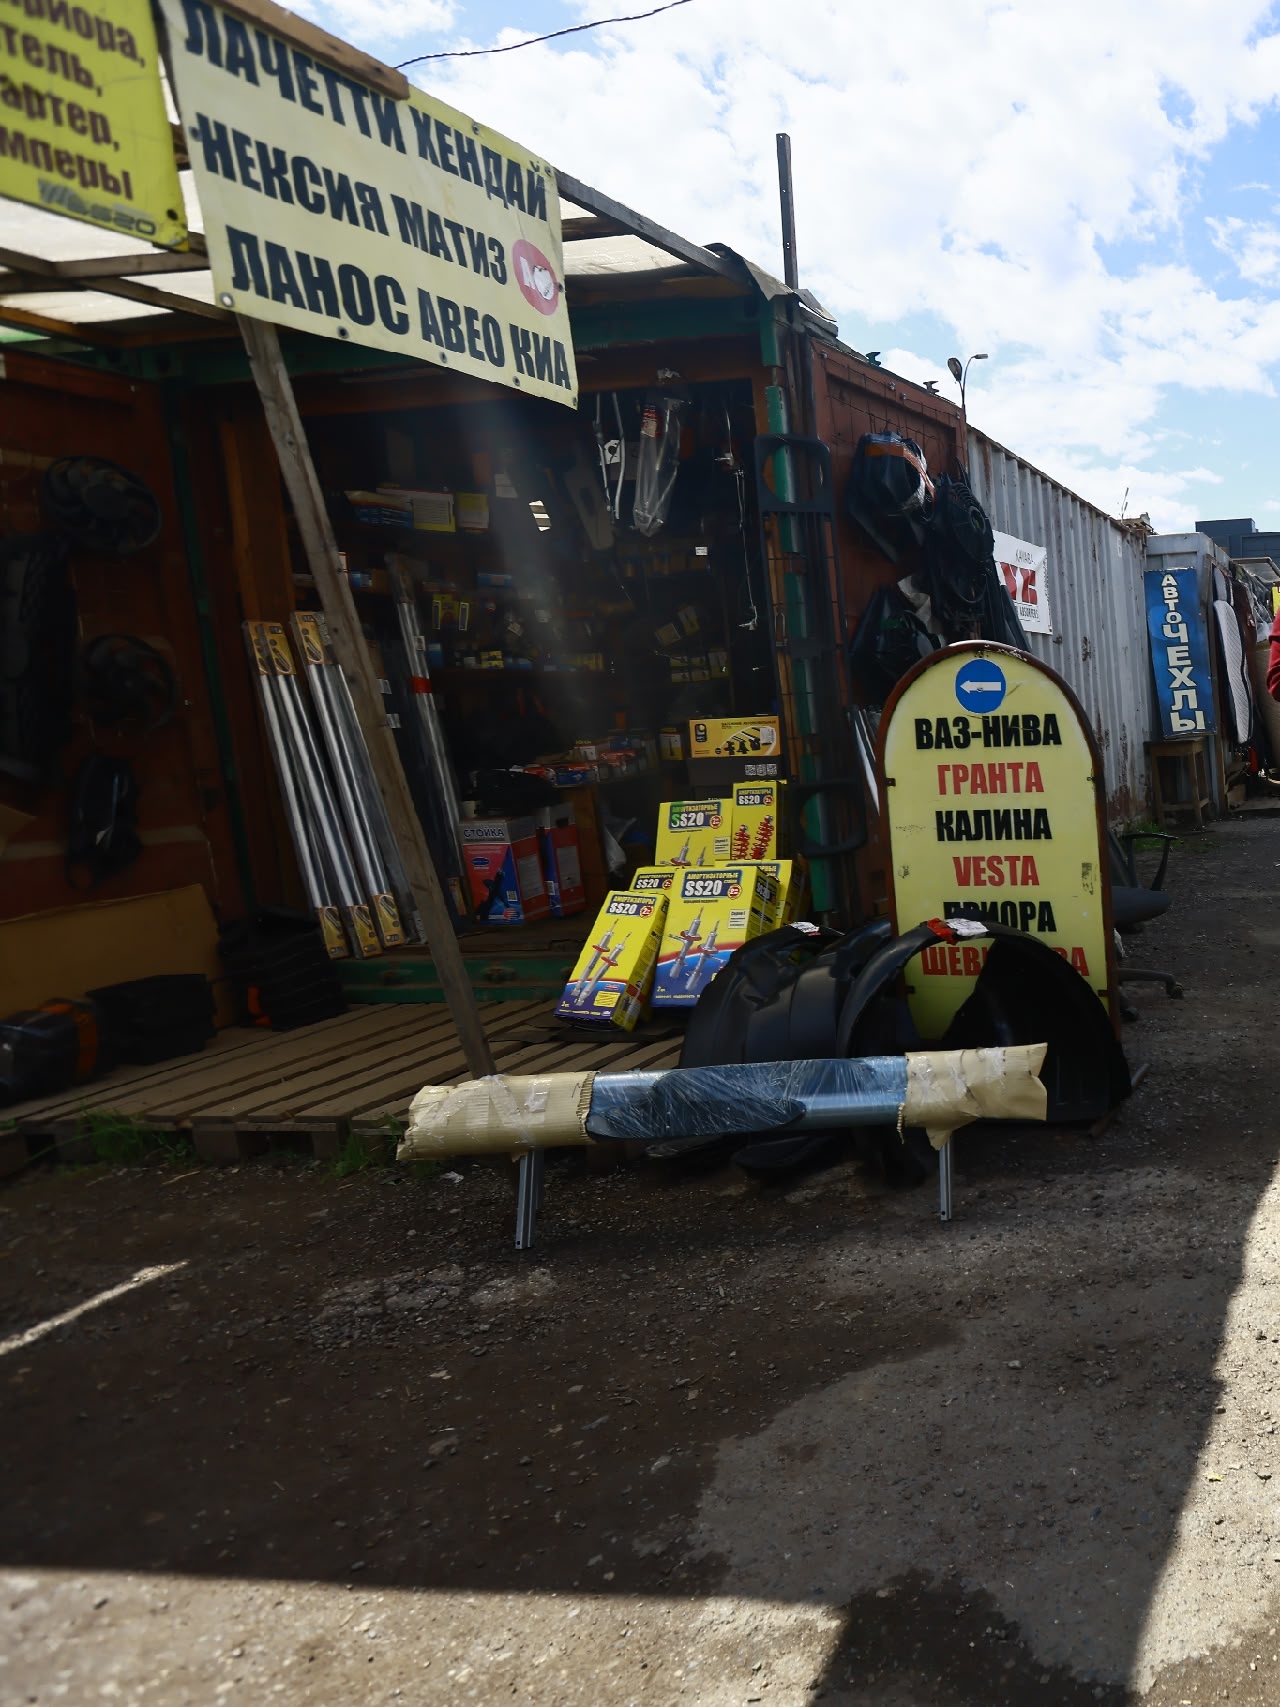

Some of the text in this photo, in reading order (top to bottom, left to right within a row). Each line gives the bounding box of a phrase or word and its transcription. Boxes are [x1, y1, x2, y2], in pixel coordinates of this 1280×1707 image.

[12, 0, 146, 68] риора,
[0, 21, 103, 98] тель,
[180, 0, 548, 221] ЛАЧЕТТИ ХЕНДАЙ
[195, 112, 389, 237] НЕКСИЯ
[390, 193, 508, 286] МАТИЗ
[225, 224, 572, 391] ЛАНОС АВЕО КИА
[1161, 574, 1206, 732] АВТОЧЕХЛЫ
[915, 713, 1062, 750] ВАЗ-НИВА
[937, 761, 1044, 796] ГРАНТА
[738, 795, 760, 805] SS20
[463, 827, 505, 839] СТОЙКА
[671, 812, 704, 828] SS20
[935, 808, 1052, 842] КАЛИНА
[636, 878, 659, 889] SS20
[685, 880, 722, 896] SS20
[953, 855, 1040, 887] VESTA
[609, 902, 638, 915] SS20
